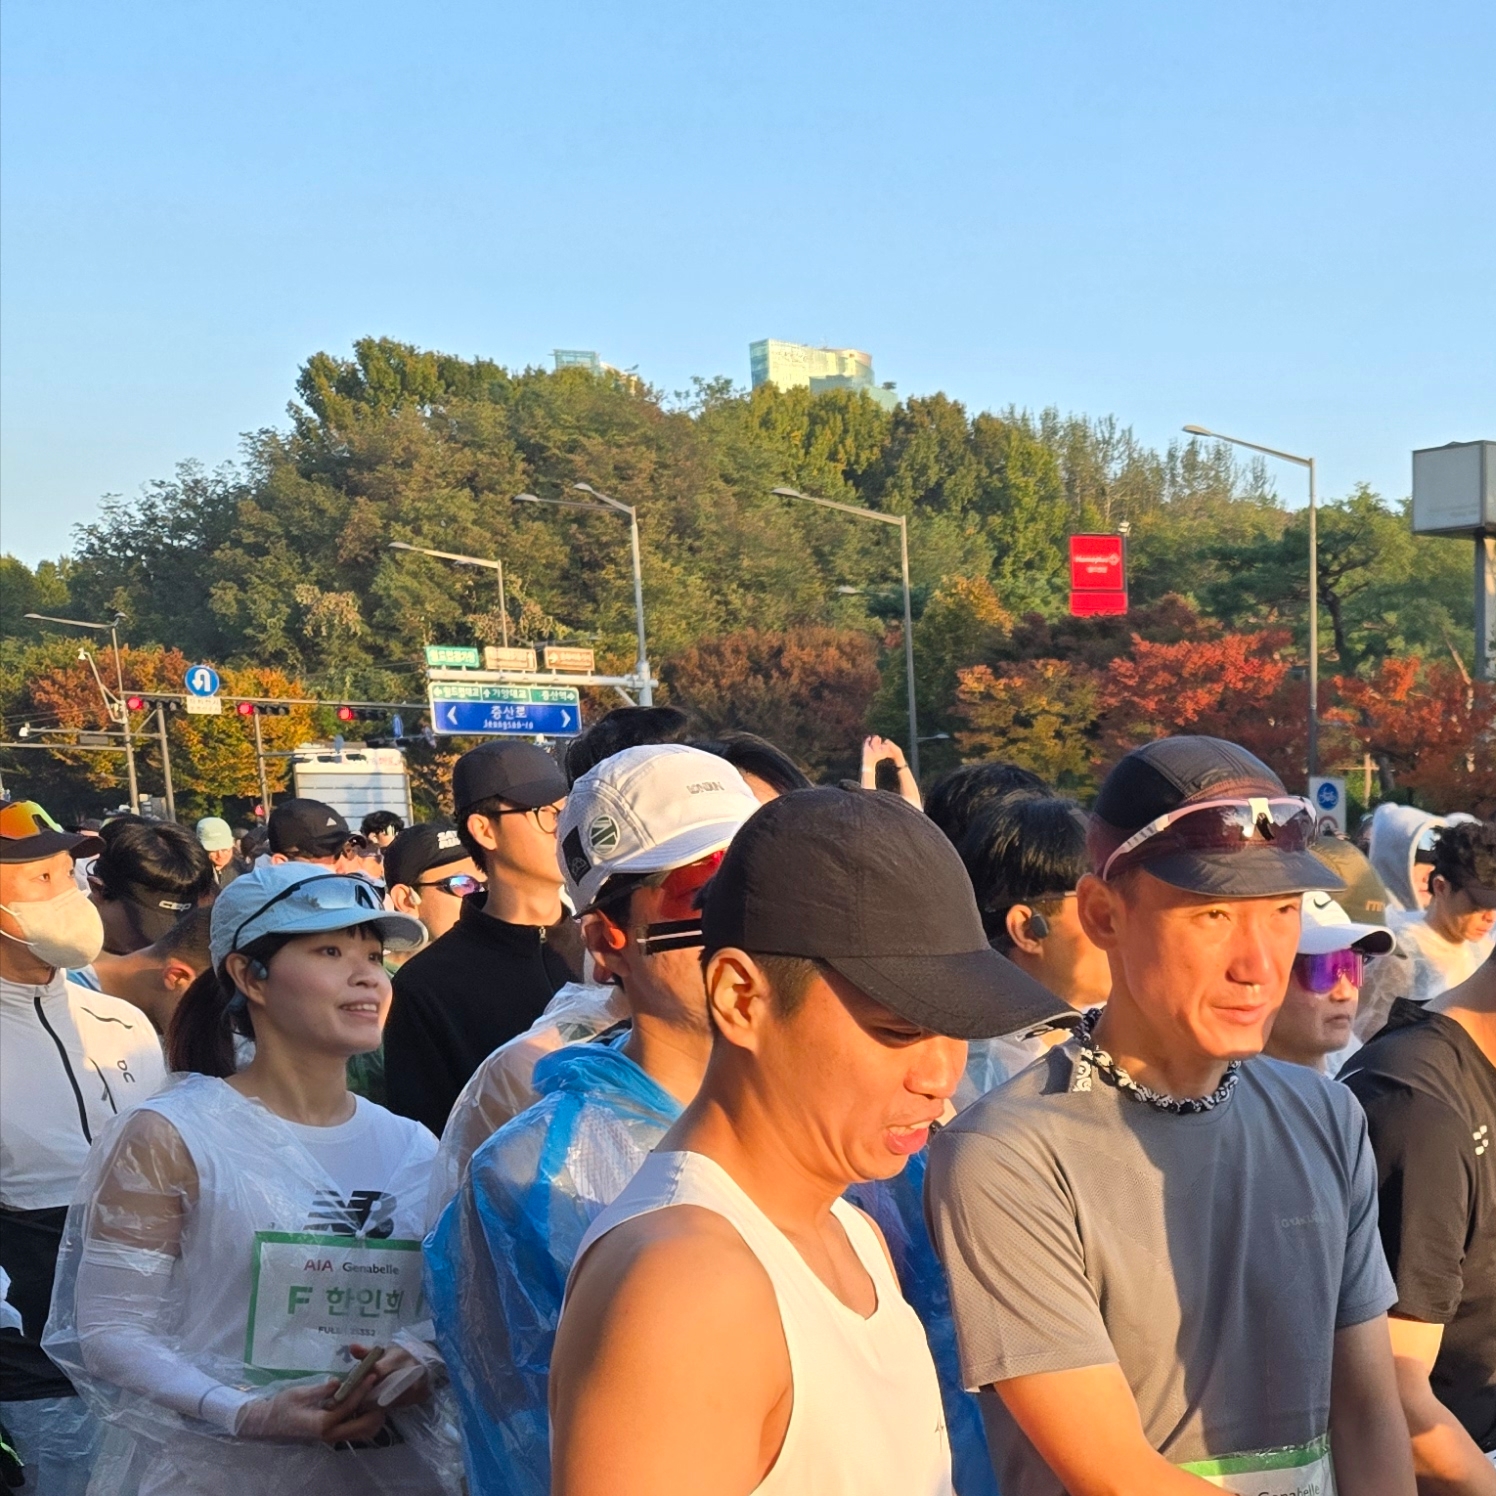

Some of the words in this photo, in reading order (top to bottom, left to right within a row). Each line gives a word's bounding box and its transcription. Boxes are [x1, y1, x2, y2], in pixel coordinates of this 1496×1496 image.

[490, 705, 527, 719] 증산로
[303, 1259, 334, 1272] AIA
[342, 1261, 399, 1275] Genabelle
[287, 1285, 313, 1314] F
